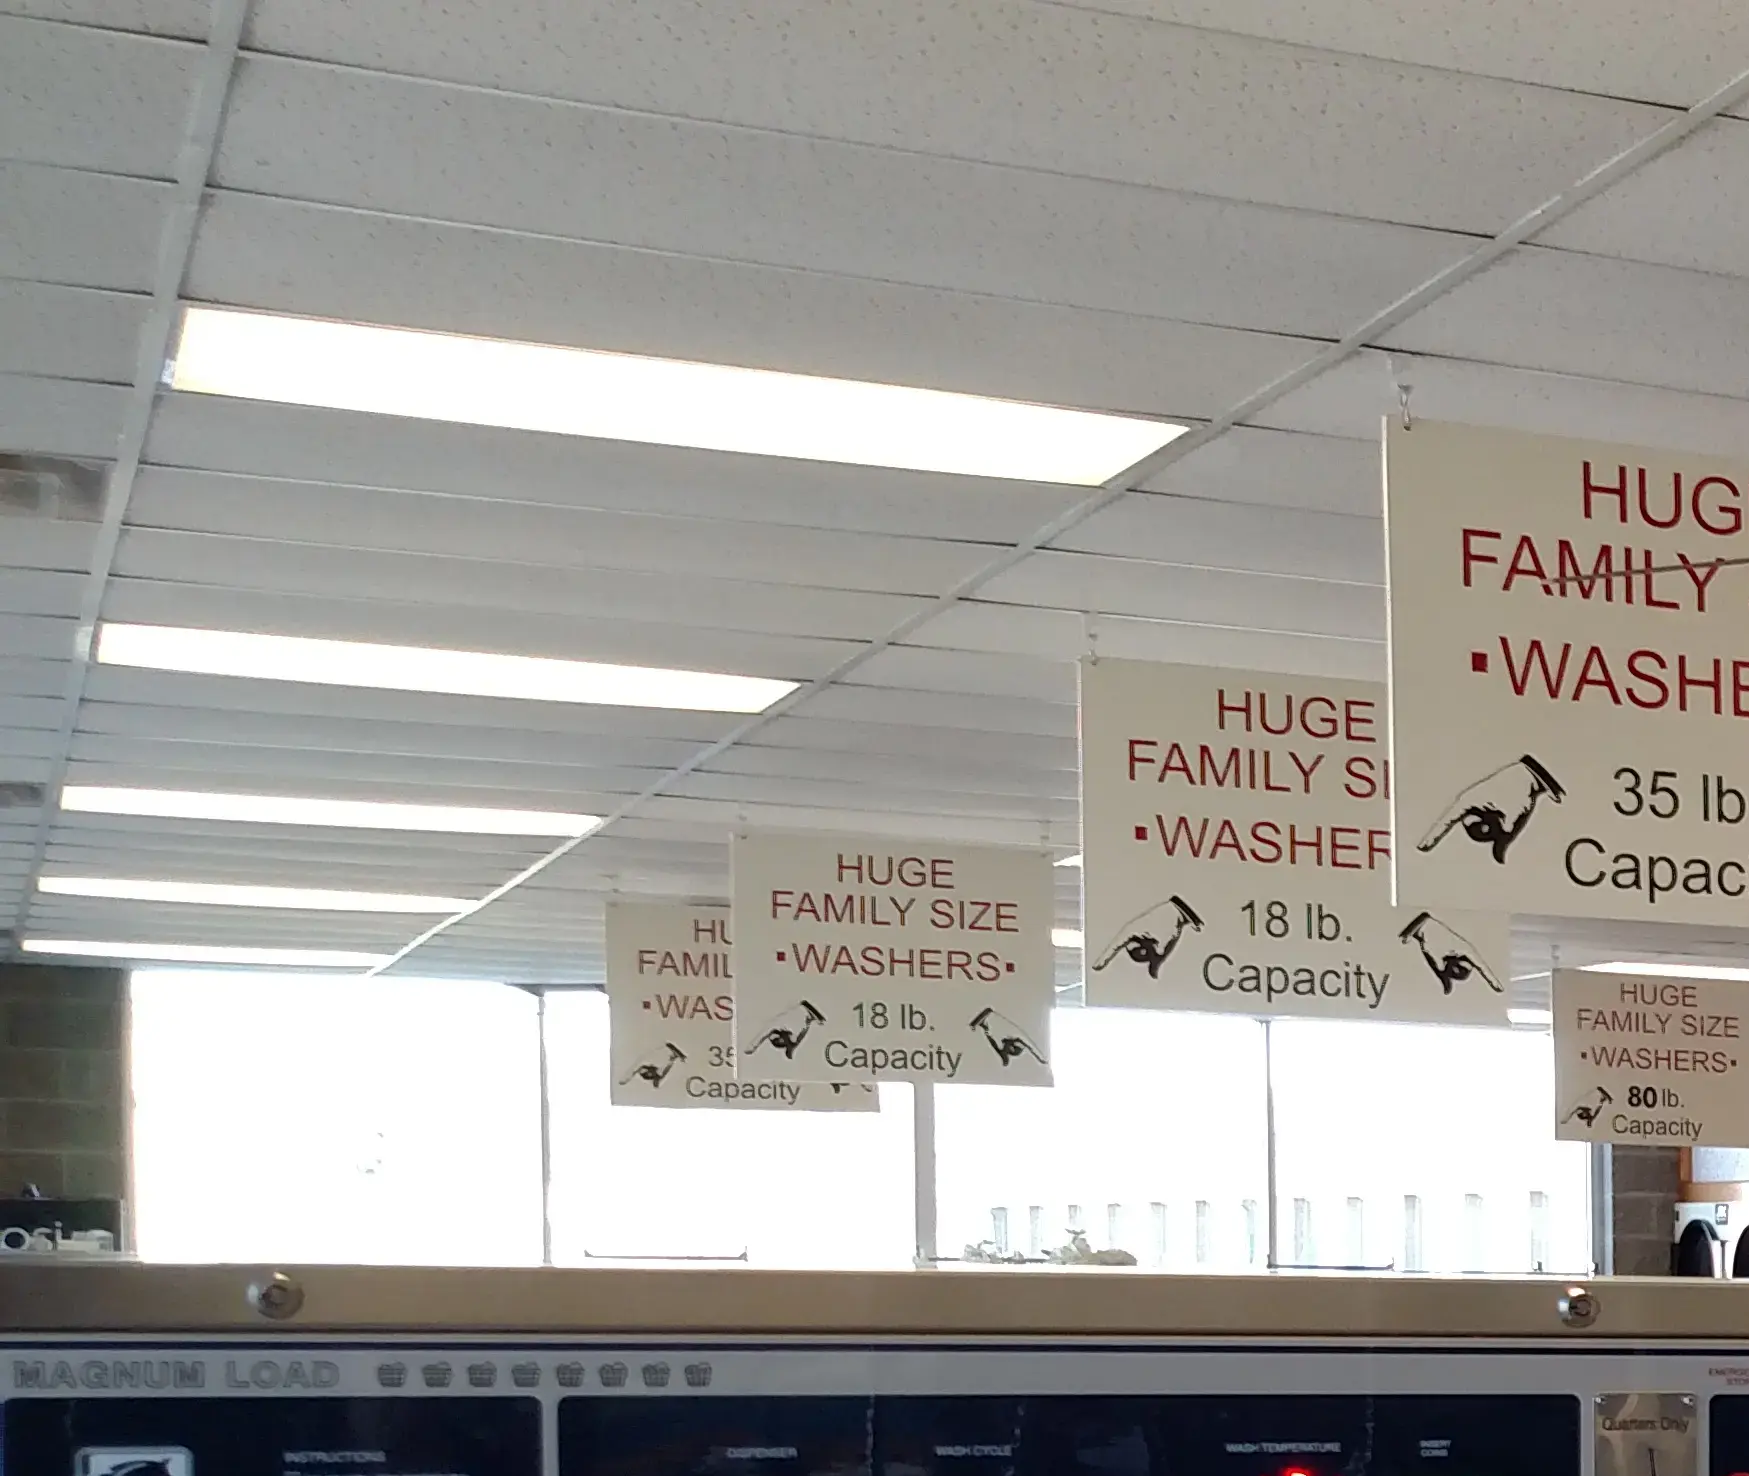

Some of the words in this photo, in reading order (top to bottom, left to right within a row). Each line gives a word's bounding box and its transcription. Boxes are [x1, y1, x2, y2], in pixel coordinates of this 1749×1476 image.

[1461, 528, 1726, 612] FAMILY
[1218, 689, 1376, 743] HUGE
[1128, 739, 1325, 794] FAMILY
[1344, 757, 1390, 799] SI
[1613, 767, 1679, 818] 35
[1156, 814, 1391, 869] WASHER
[837, 853, 955, 889] HUGE
[771, 890, 915, 926] FAMILY
[930, 900, 1019, 933] SIZE
[1242, 900, 1289, 939] 18
[1307, 903, 1352, 942] lb.
[693, 918, 733, 945] HU
[639, 949, 733, 978] FAMIL
[792, 943, 1001, 982] WASHERS
[1203, 953, 1389, 1009] Capacity
[1620, 982, 1698, 1007] HUGE
[852, 1002, 889, 1030] 18
[901, 1004, 935, 1031] lb.
[1577, 1008, 1672, 1034] FAMILY
[1680, 1014, 1740, 1038] SIZE
[824, 1040, 962, 1077] Capacity
[1591, 1046, 1728, 1073] WASHERS
[686, 1077, 800, 1105] Capacity
[1627, 1085, 1658, 1109] 80
[1662, 1089, 1685, 1108] lb.
[1612, 1114, 1702, 1141] Capacity
[13, 1361, 206, 1389] MAGNUM
[225, 1361, 340, 1389] LOAD
[1660, 1416, 1689, 1433] Only
